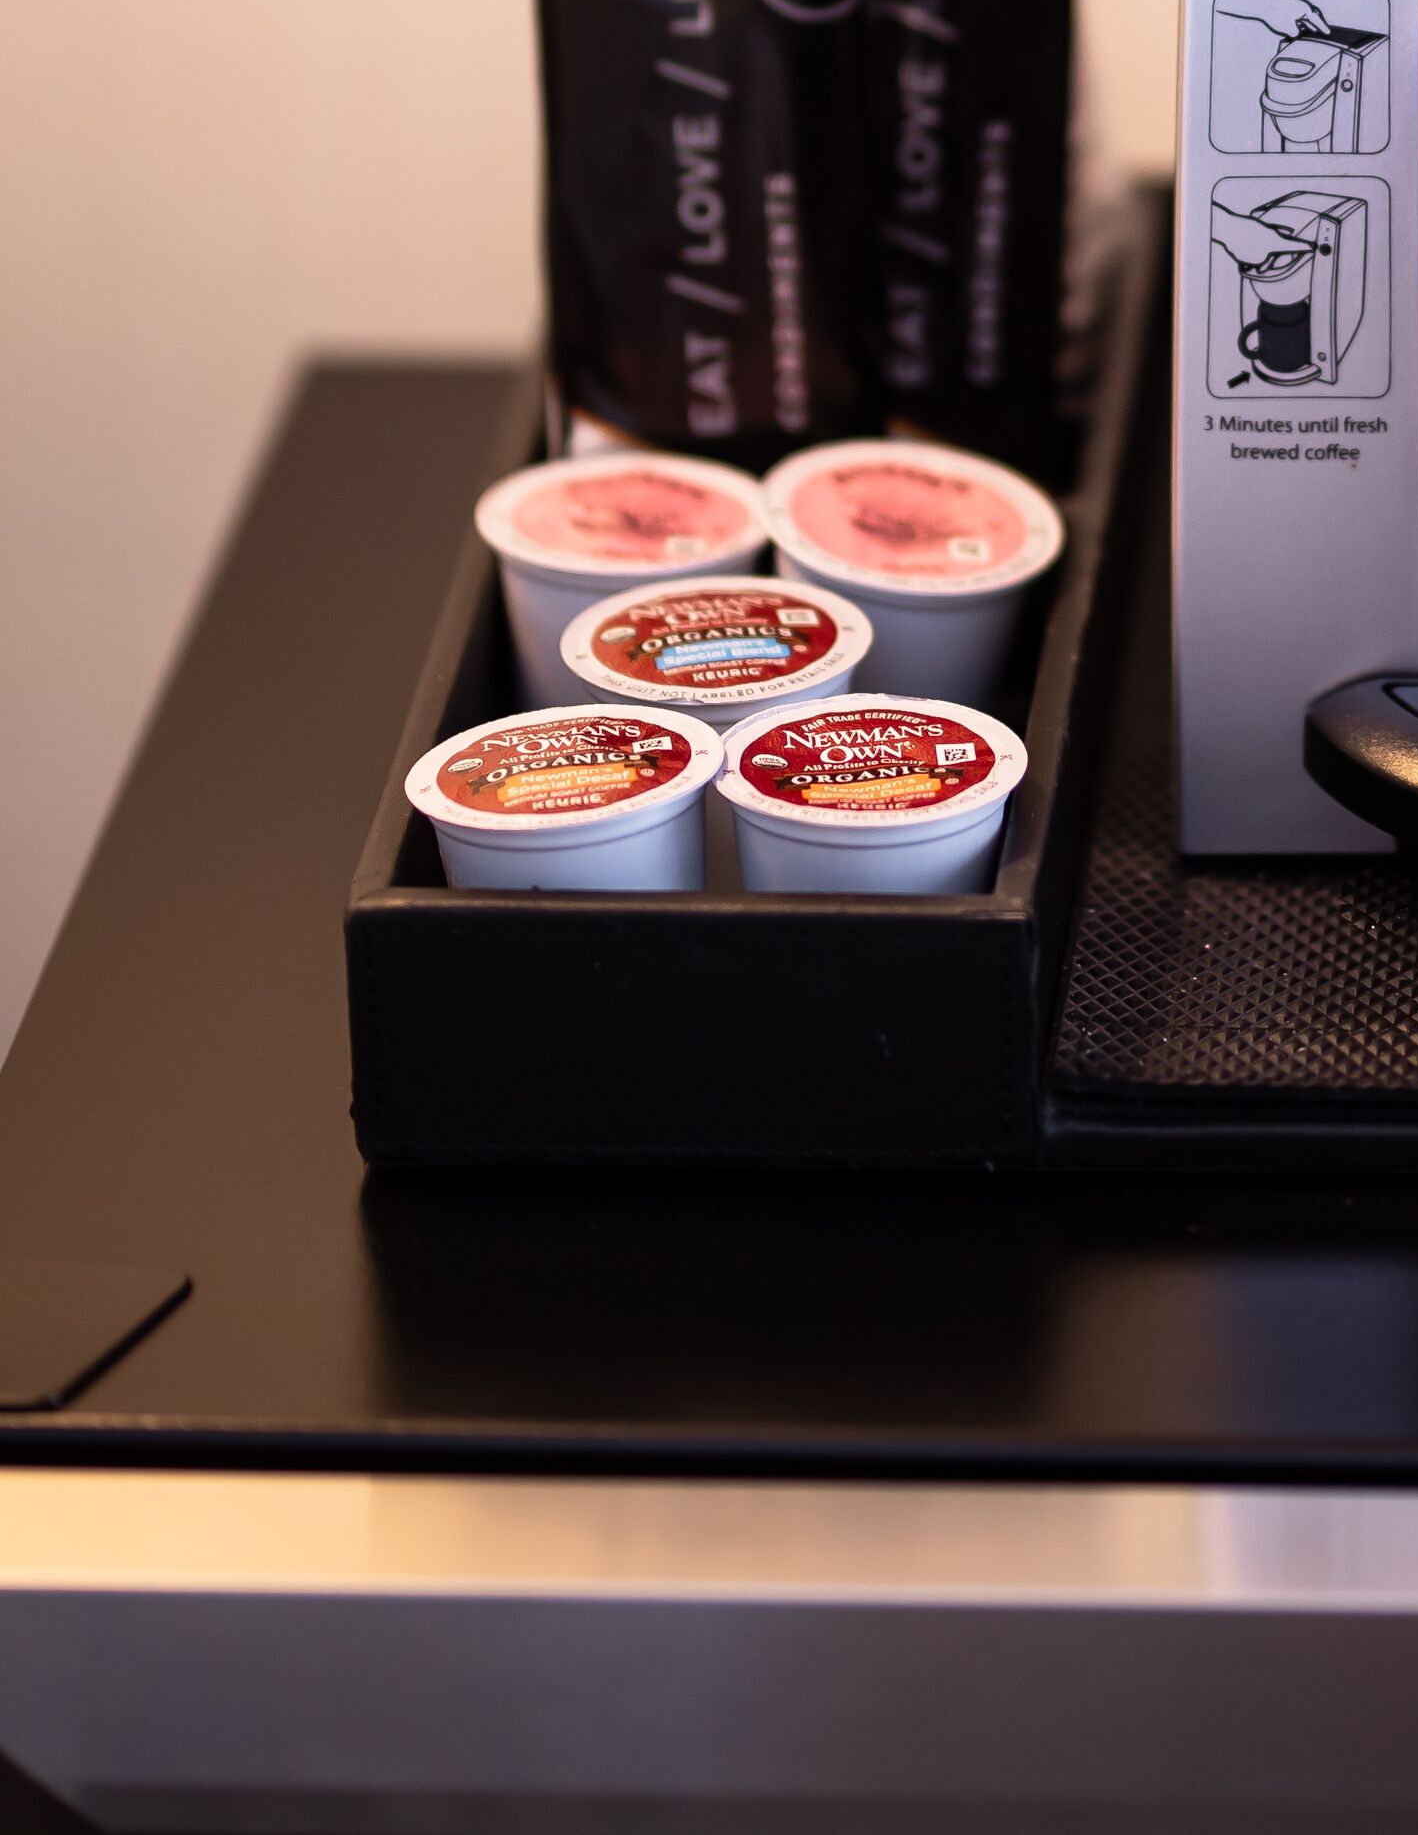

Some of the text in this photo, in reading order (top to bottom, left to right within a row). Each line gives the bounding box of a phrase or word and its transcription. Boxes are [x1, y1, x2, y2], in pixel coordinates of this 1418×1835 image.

[895, 58, 947, 212] LOVE
[671, 116, 729, 266] LOVE
[684, 331, 737, 437] EAT
[1203, 415, 1388, 433] 3 Minutes until fresh
[1230, 443, 1361, 461] brewed coffee
[641, 626, 793, 653] ORGANICS
[692, 667, 760, 683] KEURIG
[759, 680, 786, 694] FOR
[800, 718, 827, 732] FAIR
[827, 713, 862, 723] TRADE
[481, 724, 642, 753] NEWMAN'S
[515, 733, 600, 754] OWN
[782, 723, 944, 750] NEWMAN'S
[499, 756, 519, 765] All
[819, 741, 904, 764] OWN
[485, 752, 642, 783] ORGANICS
[803, 762, 823, 772] All
[506, 770, 630, 797] Special Decaf
[823, 777, 918, 793] Newman's
[879, 781, 933, 798] Decaf
[531, 793, 603, 811] KEURIG
